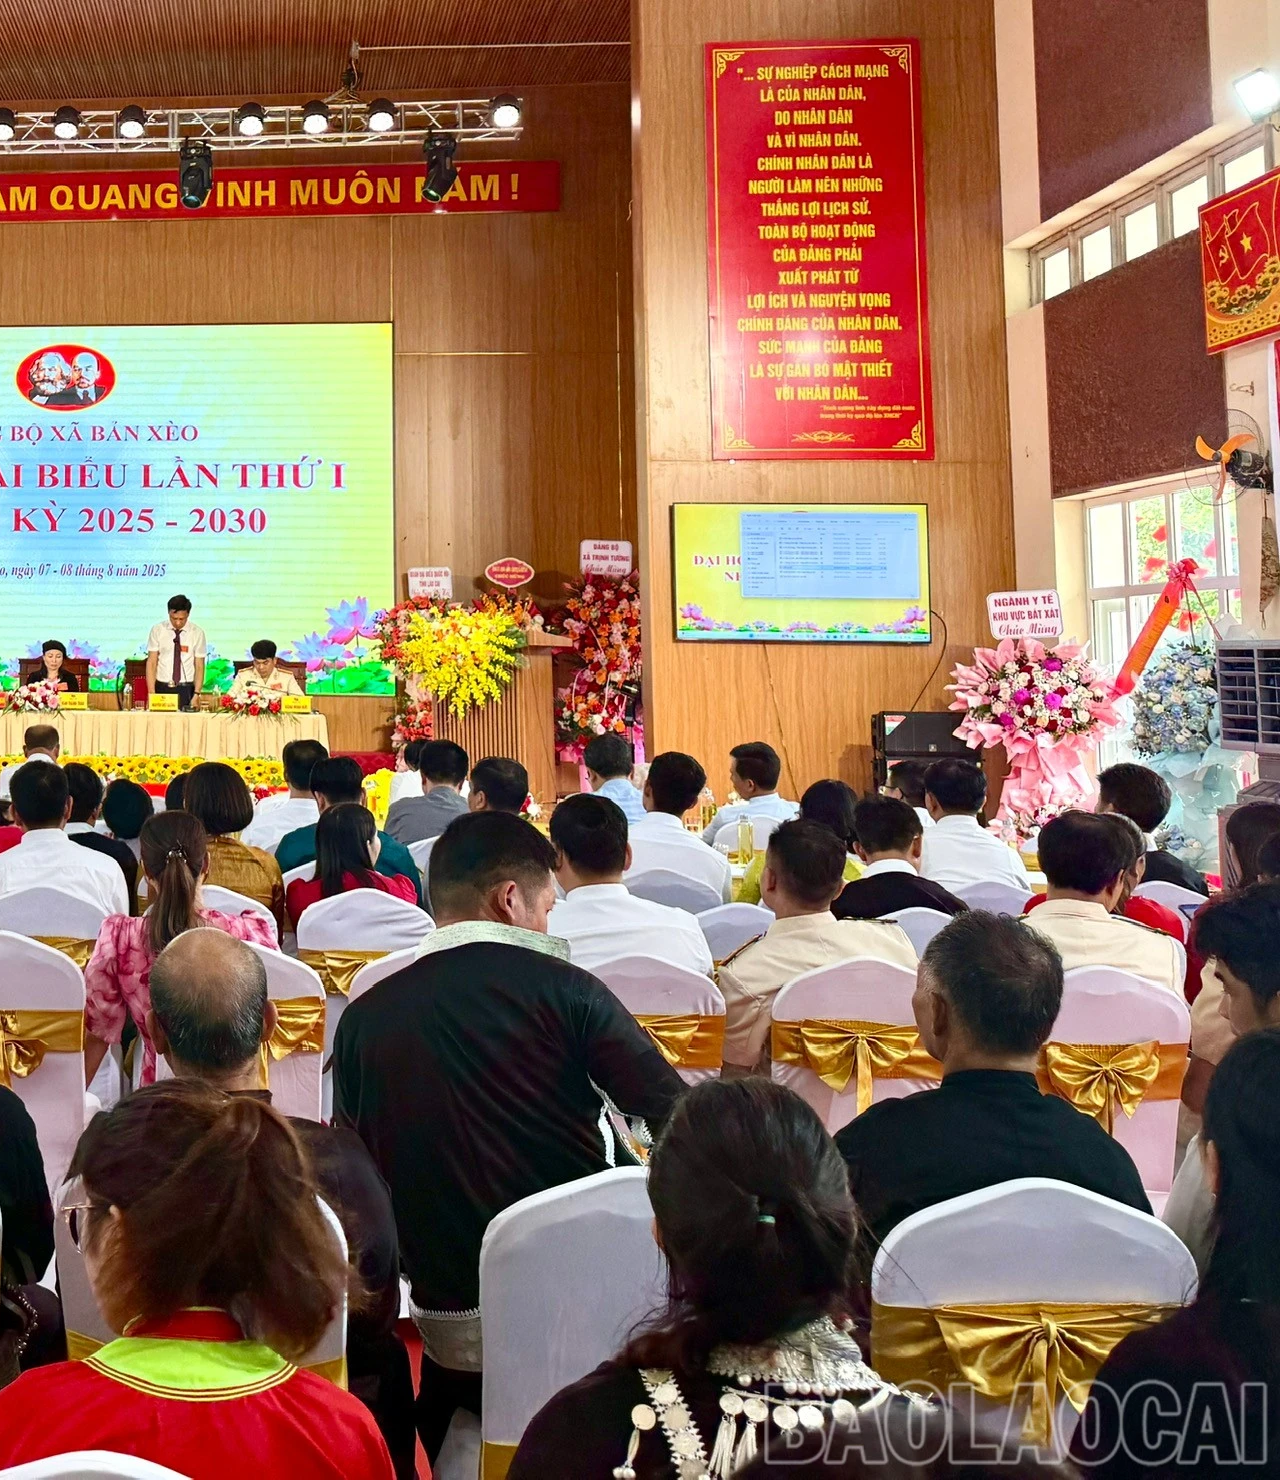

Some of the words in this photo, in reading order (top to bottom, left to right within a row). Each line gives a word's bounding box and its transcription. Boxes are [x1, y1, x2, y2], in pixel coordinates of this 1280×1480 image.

[757, 66, 774, 81] SỰ
[776, 63, 818, 82] NGHIỆP
[821, 62, 851, 78] CÁCH
[855, 65, 889, 80] MẠNG
[760, 86, 775, 102] LÀ
[778, 85, 801, 101] CỦA
[804, 85, 836, 100] NHÂN
[839, 84, 866, 101] DÂN,
[775, 111, 790, 125] DO
[794, 107, 826, 124] NHÂN
[829, 107, 853, 124] DÂN
[767, 132, 782, 148] VÀ
[785, 131, 796, 147] VÌ
[799, 131, 831, 147] NHÂN
[834, 130, 862, 146] DÂN.
[757, 154, 793, 170] CHÍNH
[796, 153, 828, 169] NHÂN
[832, 153, 856, 169] DÂN
[858, 153, 873, 169] LÀ
[50, 183, 178, 211] QUANG
[291, 171, 401, 206] MUÔN
[511, 173, 519, 201] !
[749, 177, 784, 194] NGƯỜI
[787, 176, 812, 193] LÀM
[816, 175, 840, 192] NÊN
[802, 201, 820, 217] LỢI
[823, 202, 849, 218] LỊCH
[852, 198, 871, 215] SỬ.
[758, 223, 789, 239] TOÀN
[792, 220, 808, 241] BỘ
[811, 225, 840, 240] HOẠT
[843, 221, 876, 240] ĐỘNG
[773, 245, 797, 262] CỦA
[799, 245, 832, 261] ĐẢNG
[835, 244, 862, 261] PHẢI
[811, 268, 841, 284] PHÁT
[843, 267, 859, 284] TỪ
[747, 293, 765, 311] LỢI
[769, 291, 788, 308] ÍCH
[791, 291, 807, 308] VÀ
[859, 294, 891, 308] VỌNG
[10, 423, 44, 446] BỘ
[51, 421, 83, 442] XÃ
[91, 421, 140, 442] BẢN
[147, 421, 200, 442] XÈO
[37, 456, 129, 488] BIỂU
[141, 456, 220, 488] LẦN
[232, 455, 323, 489] THỨ
[331, 463, 346, 489] I
[12, 499, 67, 532] KỲ
[78, 507, 155, 533] 2025
[189, 507, 267, 533] 2030
[11, 563, 36, 580] ngày
[38, 563, 51, 577] 07
[60, 563, 73, 577] 08
[75, 562, 104, 580] tháng
[107, 563, 114, 577] 8
[116, 564, 139, 577] năm
[141, 563, 167, 577] 2025
[994, 595, 1030, 607] NGÀNH
[1032, 596, 1038, 605] Y
[1041, 591, 1054, 605] TẾ
[992, 611, 1009, 621] KHU
[1010, 609, 1026, 622] VỰC
